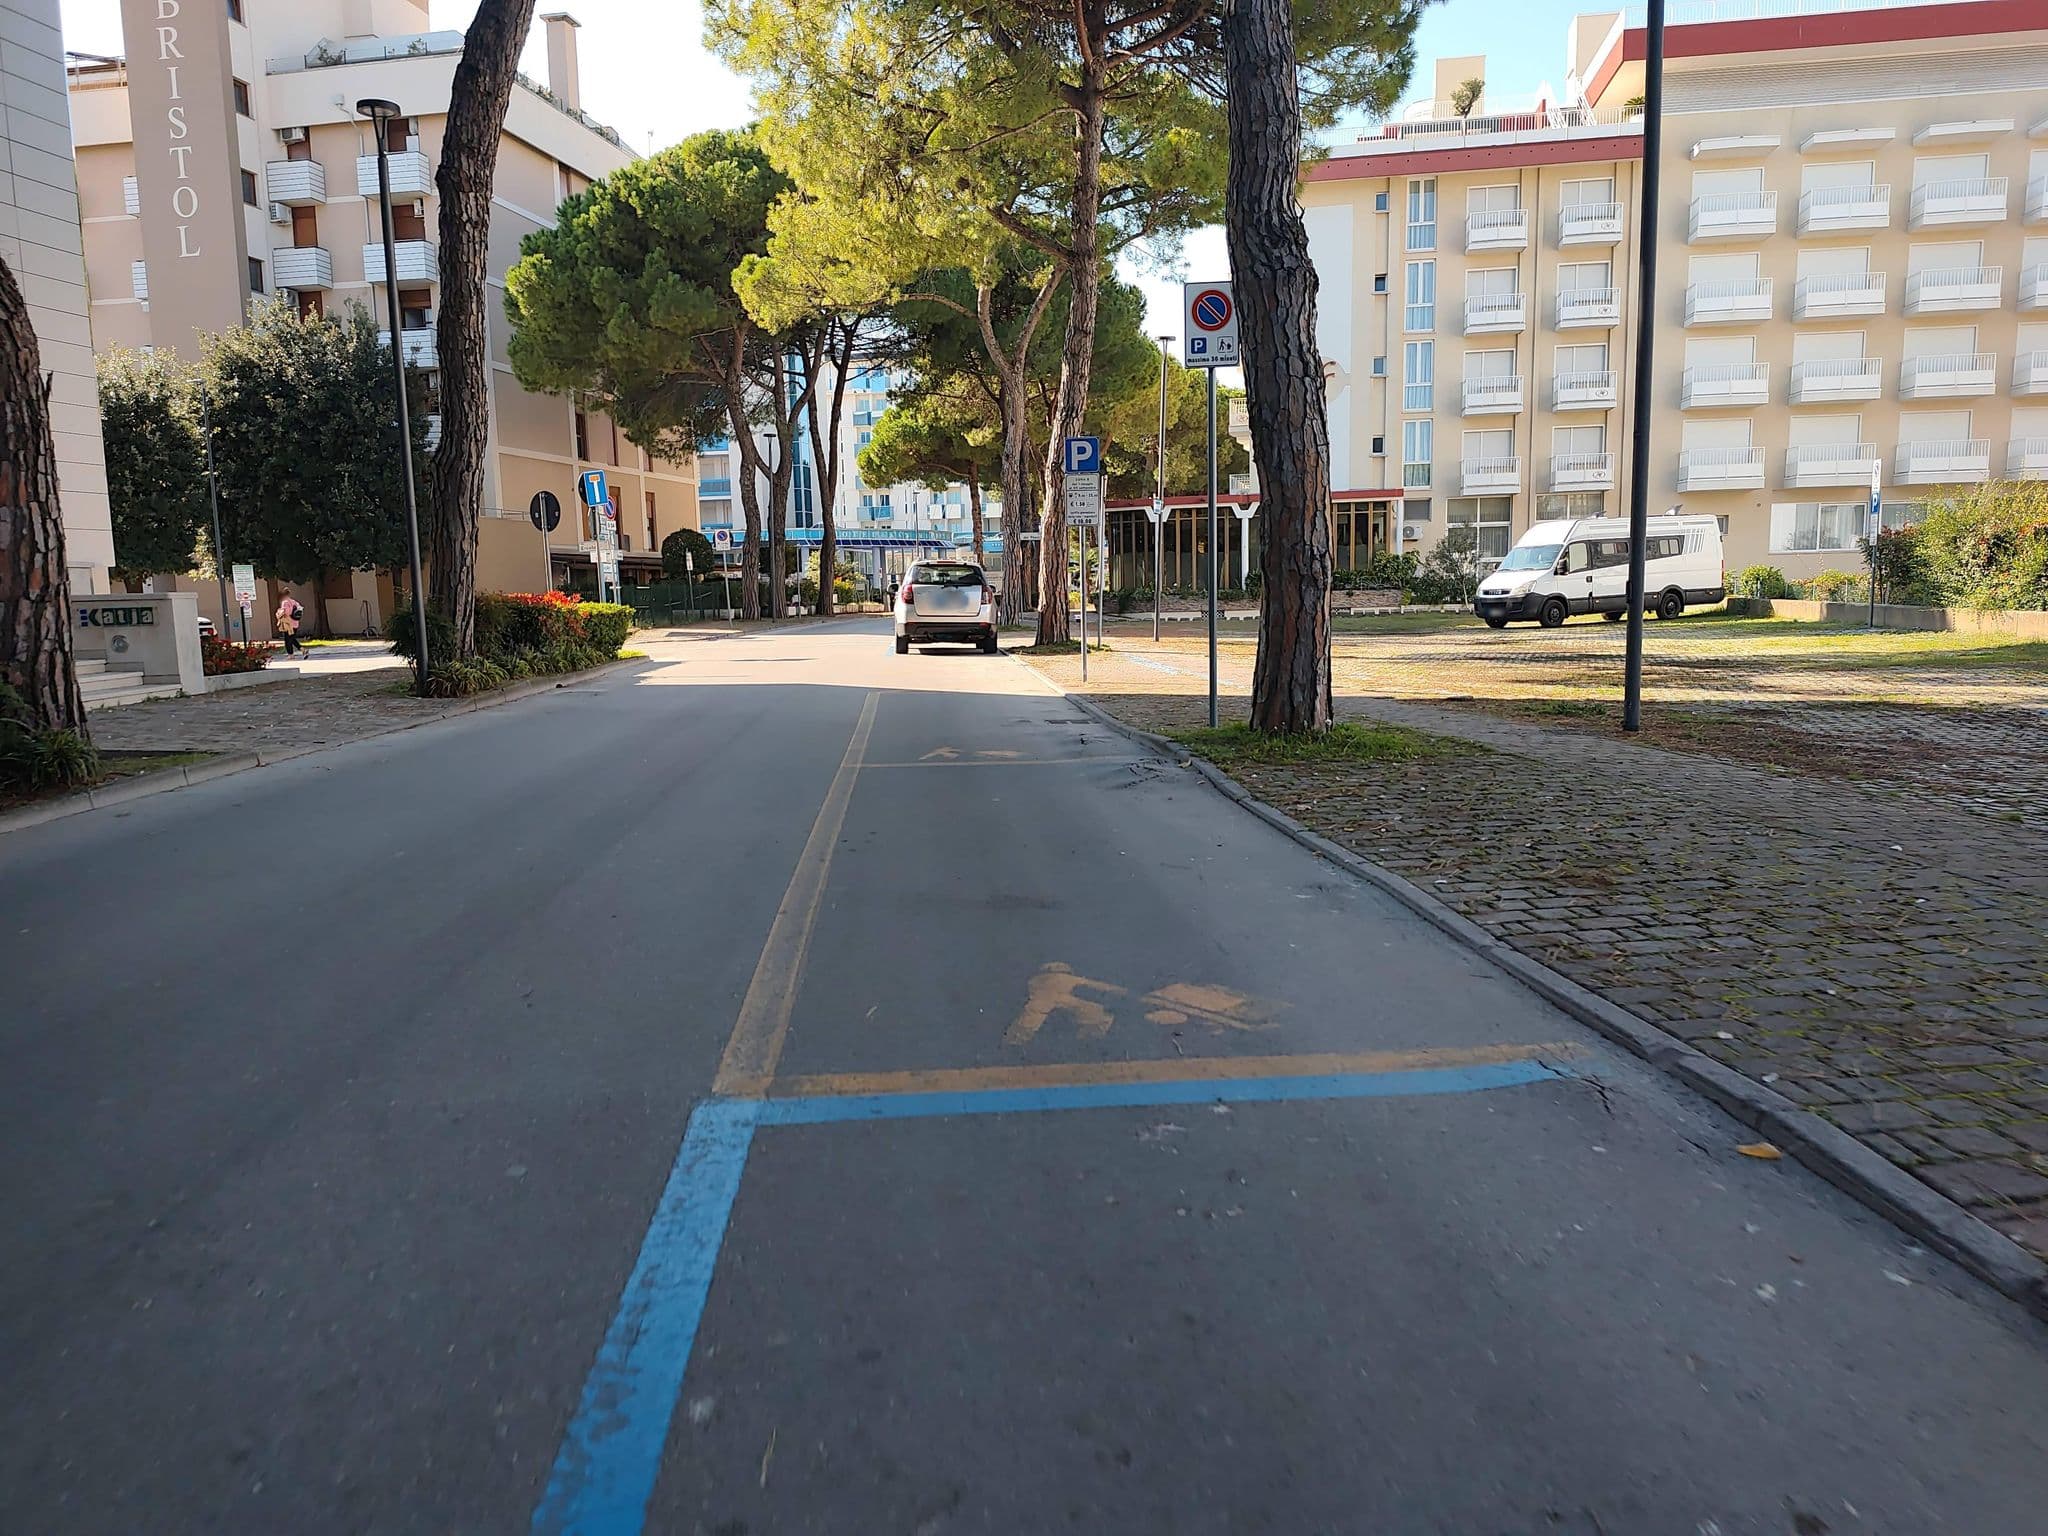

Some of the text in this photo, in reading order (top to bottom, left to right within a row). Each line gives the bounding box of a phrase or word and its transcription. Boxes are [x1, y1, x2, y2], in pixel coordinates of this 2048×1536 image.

[155, 0, 200, 258] BRISTOL
[1194, 340, 1203, 352] P
[1220, 354, 1237, 362] minuti
[1071, 441, 1093, 470] P
